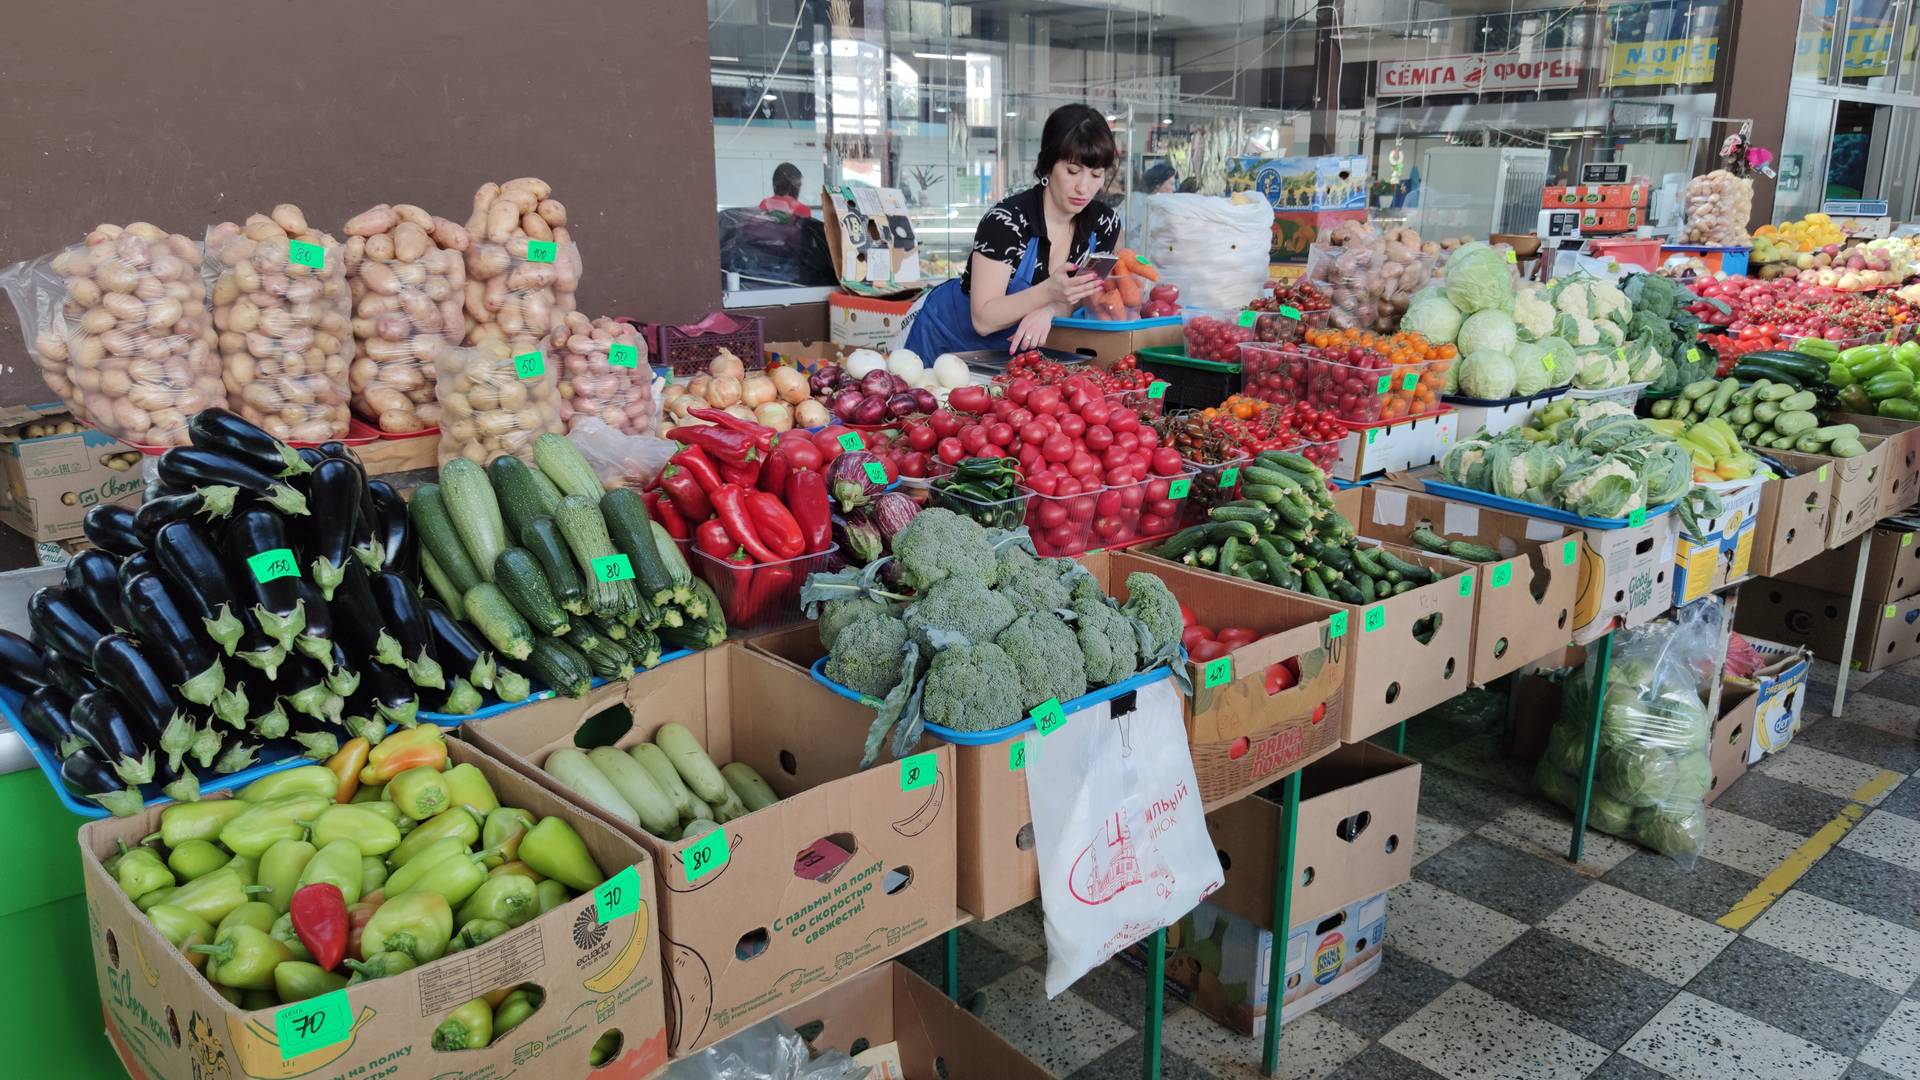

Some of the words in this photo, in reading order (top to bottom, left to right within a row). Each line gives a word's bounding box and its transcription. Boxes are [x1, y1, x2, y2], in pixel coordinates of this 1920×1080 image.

[1385, 64, 1456, 86] СЁМГА
[522, 358, 536, 374] 50
[266, 558, 291, 577] 150
[606, 562, 620, 578] 80
[1628, 567, 1653, 594] Global
[1629, 585, 1653, 611] Village
[1255, 725, 1303, 760] PRIMA
[693, 846, 712, 871] 80
[603, 886, 622, 912] 70
[773, 918, 784, 932] С
[785, 891, 832, 926] пальмы
[834, 882, 848, 896] на
[849, 860, 884, 887] полку
[791, 923, 806, 937] со
[809, 882, 873, 927] скоростью
[805, 898, 866, 945] свежести!
[576, 939, 613, 968] ecuador
[291, 1010, 326, 1039] 70
[349, 1065, 366, 1078] на
[368, 1044, 412, 1070] полку
